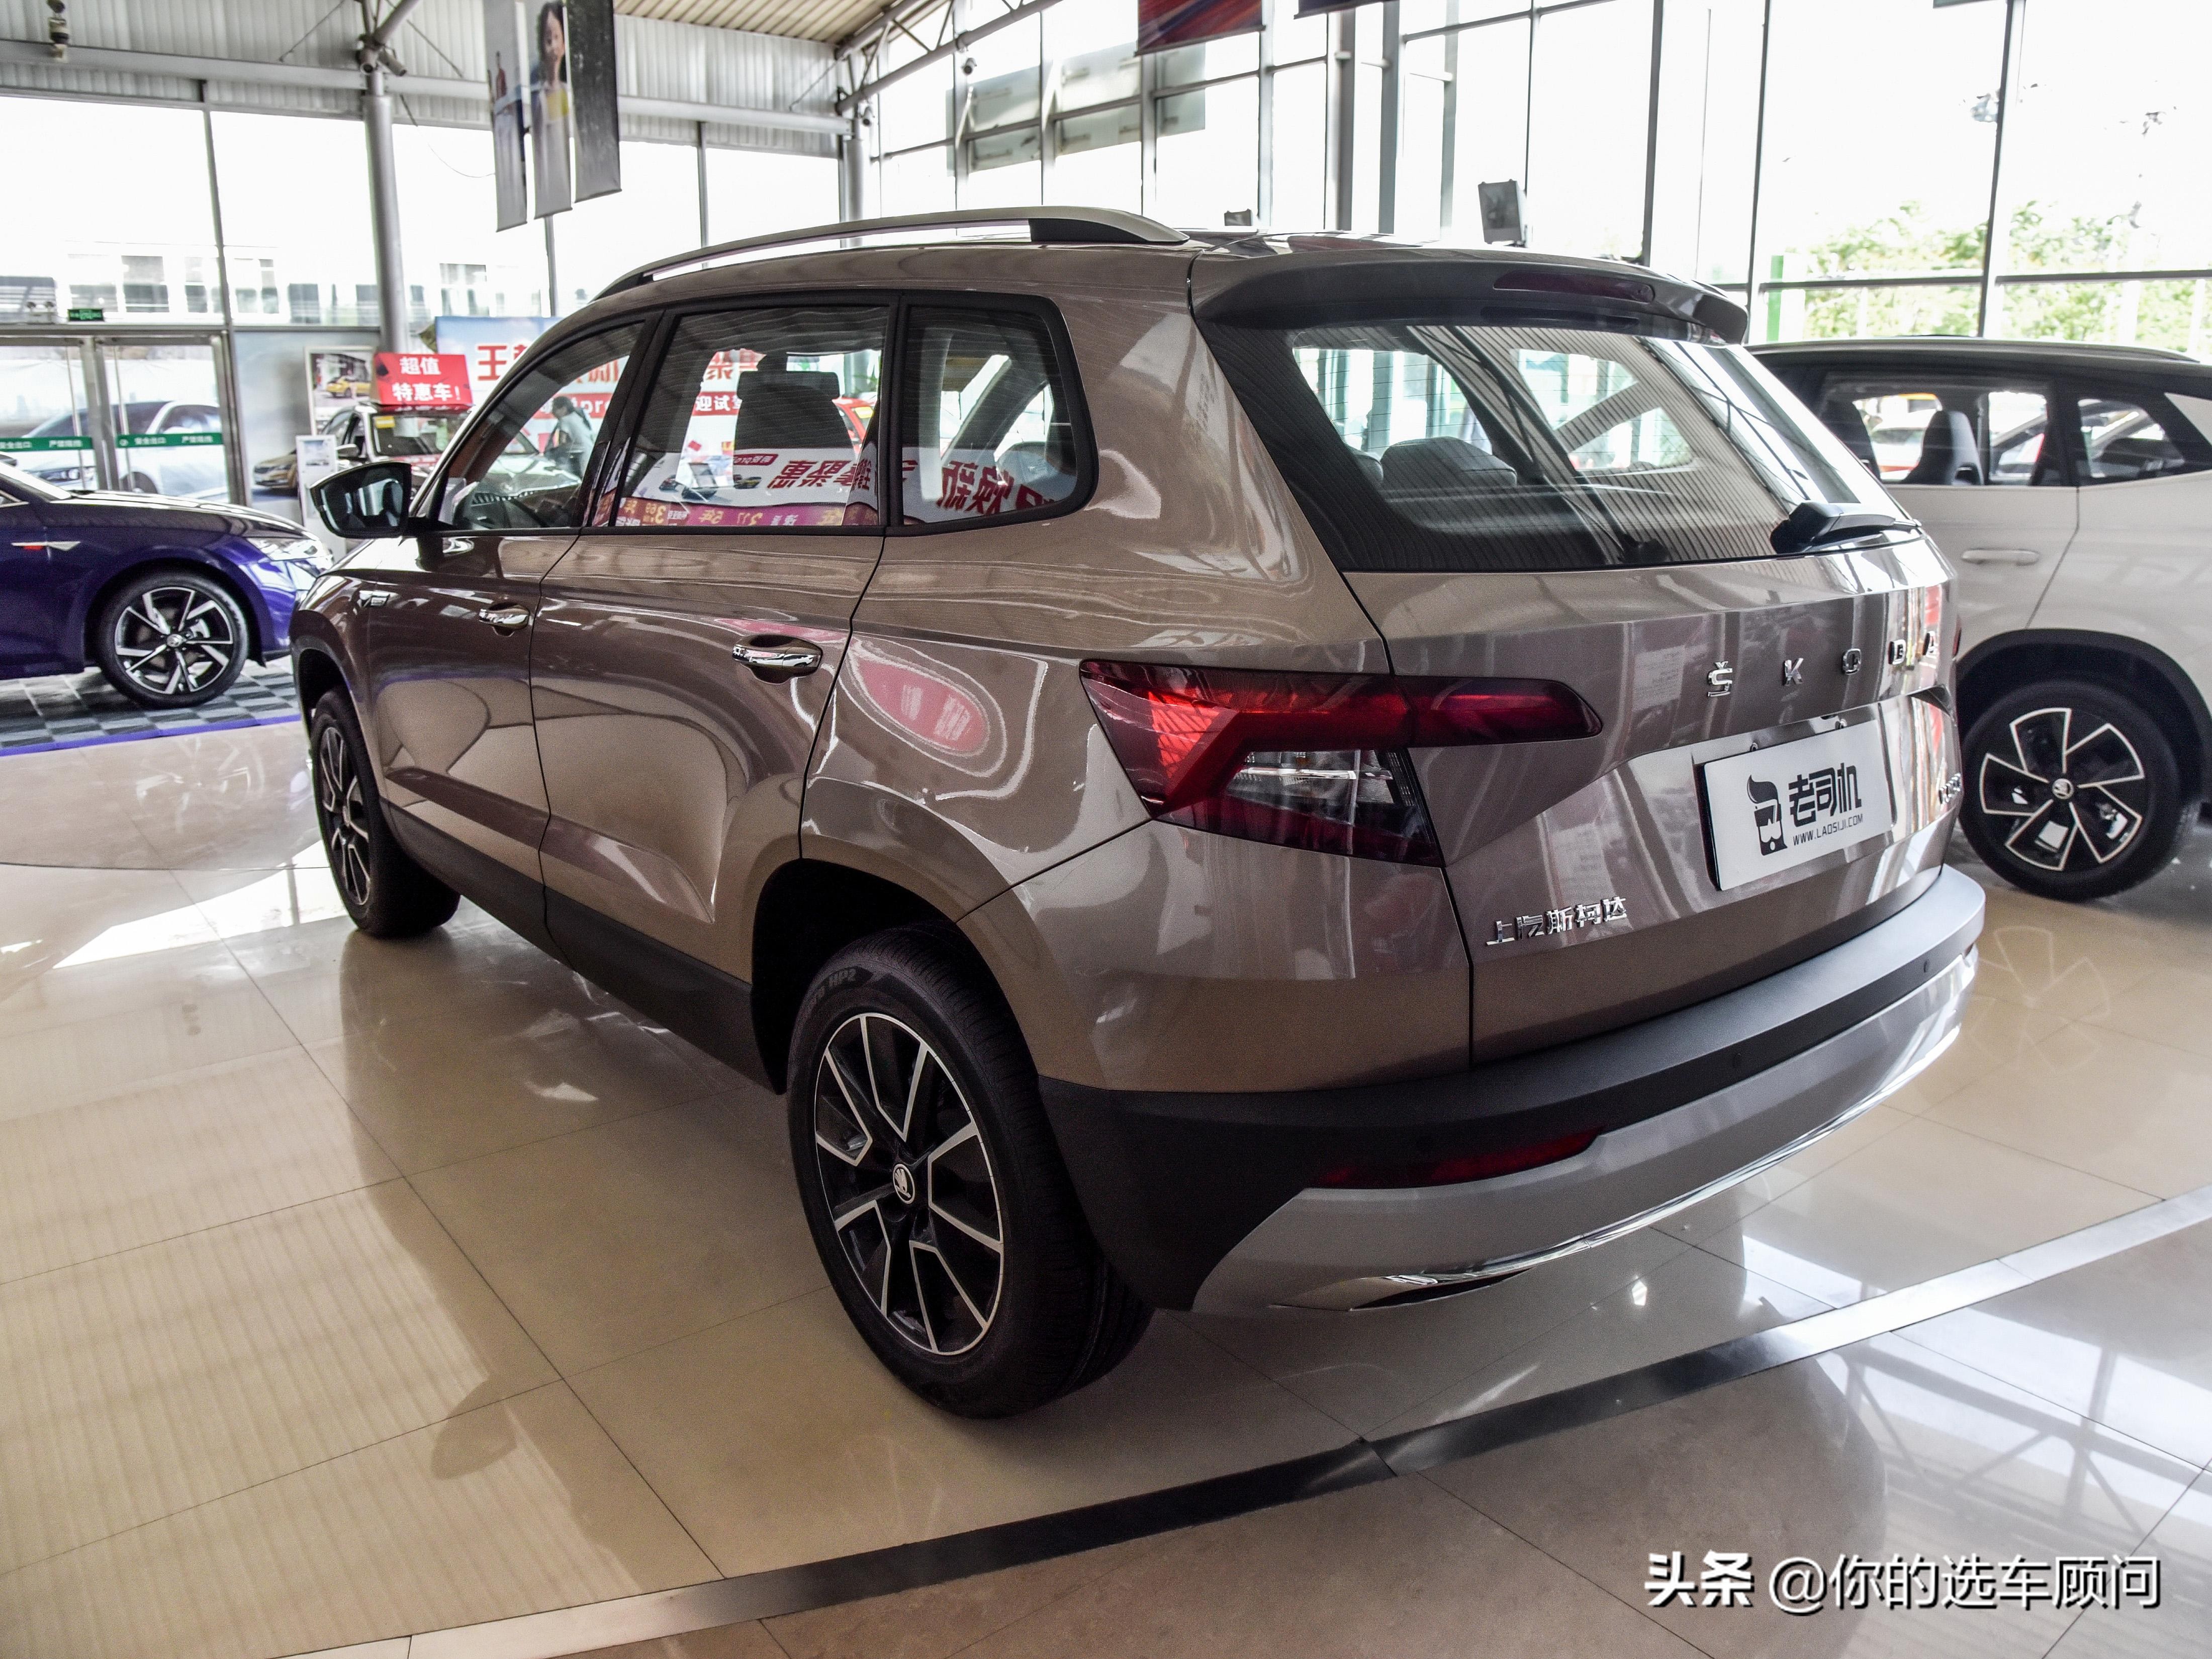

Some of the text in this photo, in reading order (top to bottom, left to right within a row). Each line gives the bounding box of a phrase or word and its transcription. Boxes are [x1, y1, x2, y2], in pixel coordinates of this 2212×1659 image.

[399, 356, 441, 375] 超值
[1787, 763, 1862, 827] 老司机
[1792, 813, 1864, 846] WWW.LAOSIJI.COM
[1486, 896, 1628, 946] 上汽斯柯达
